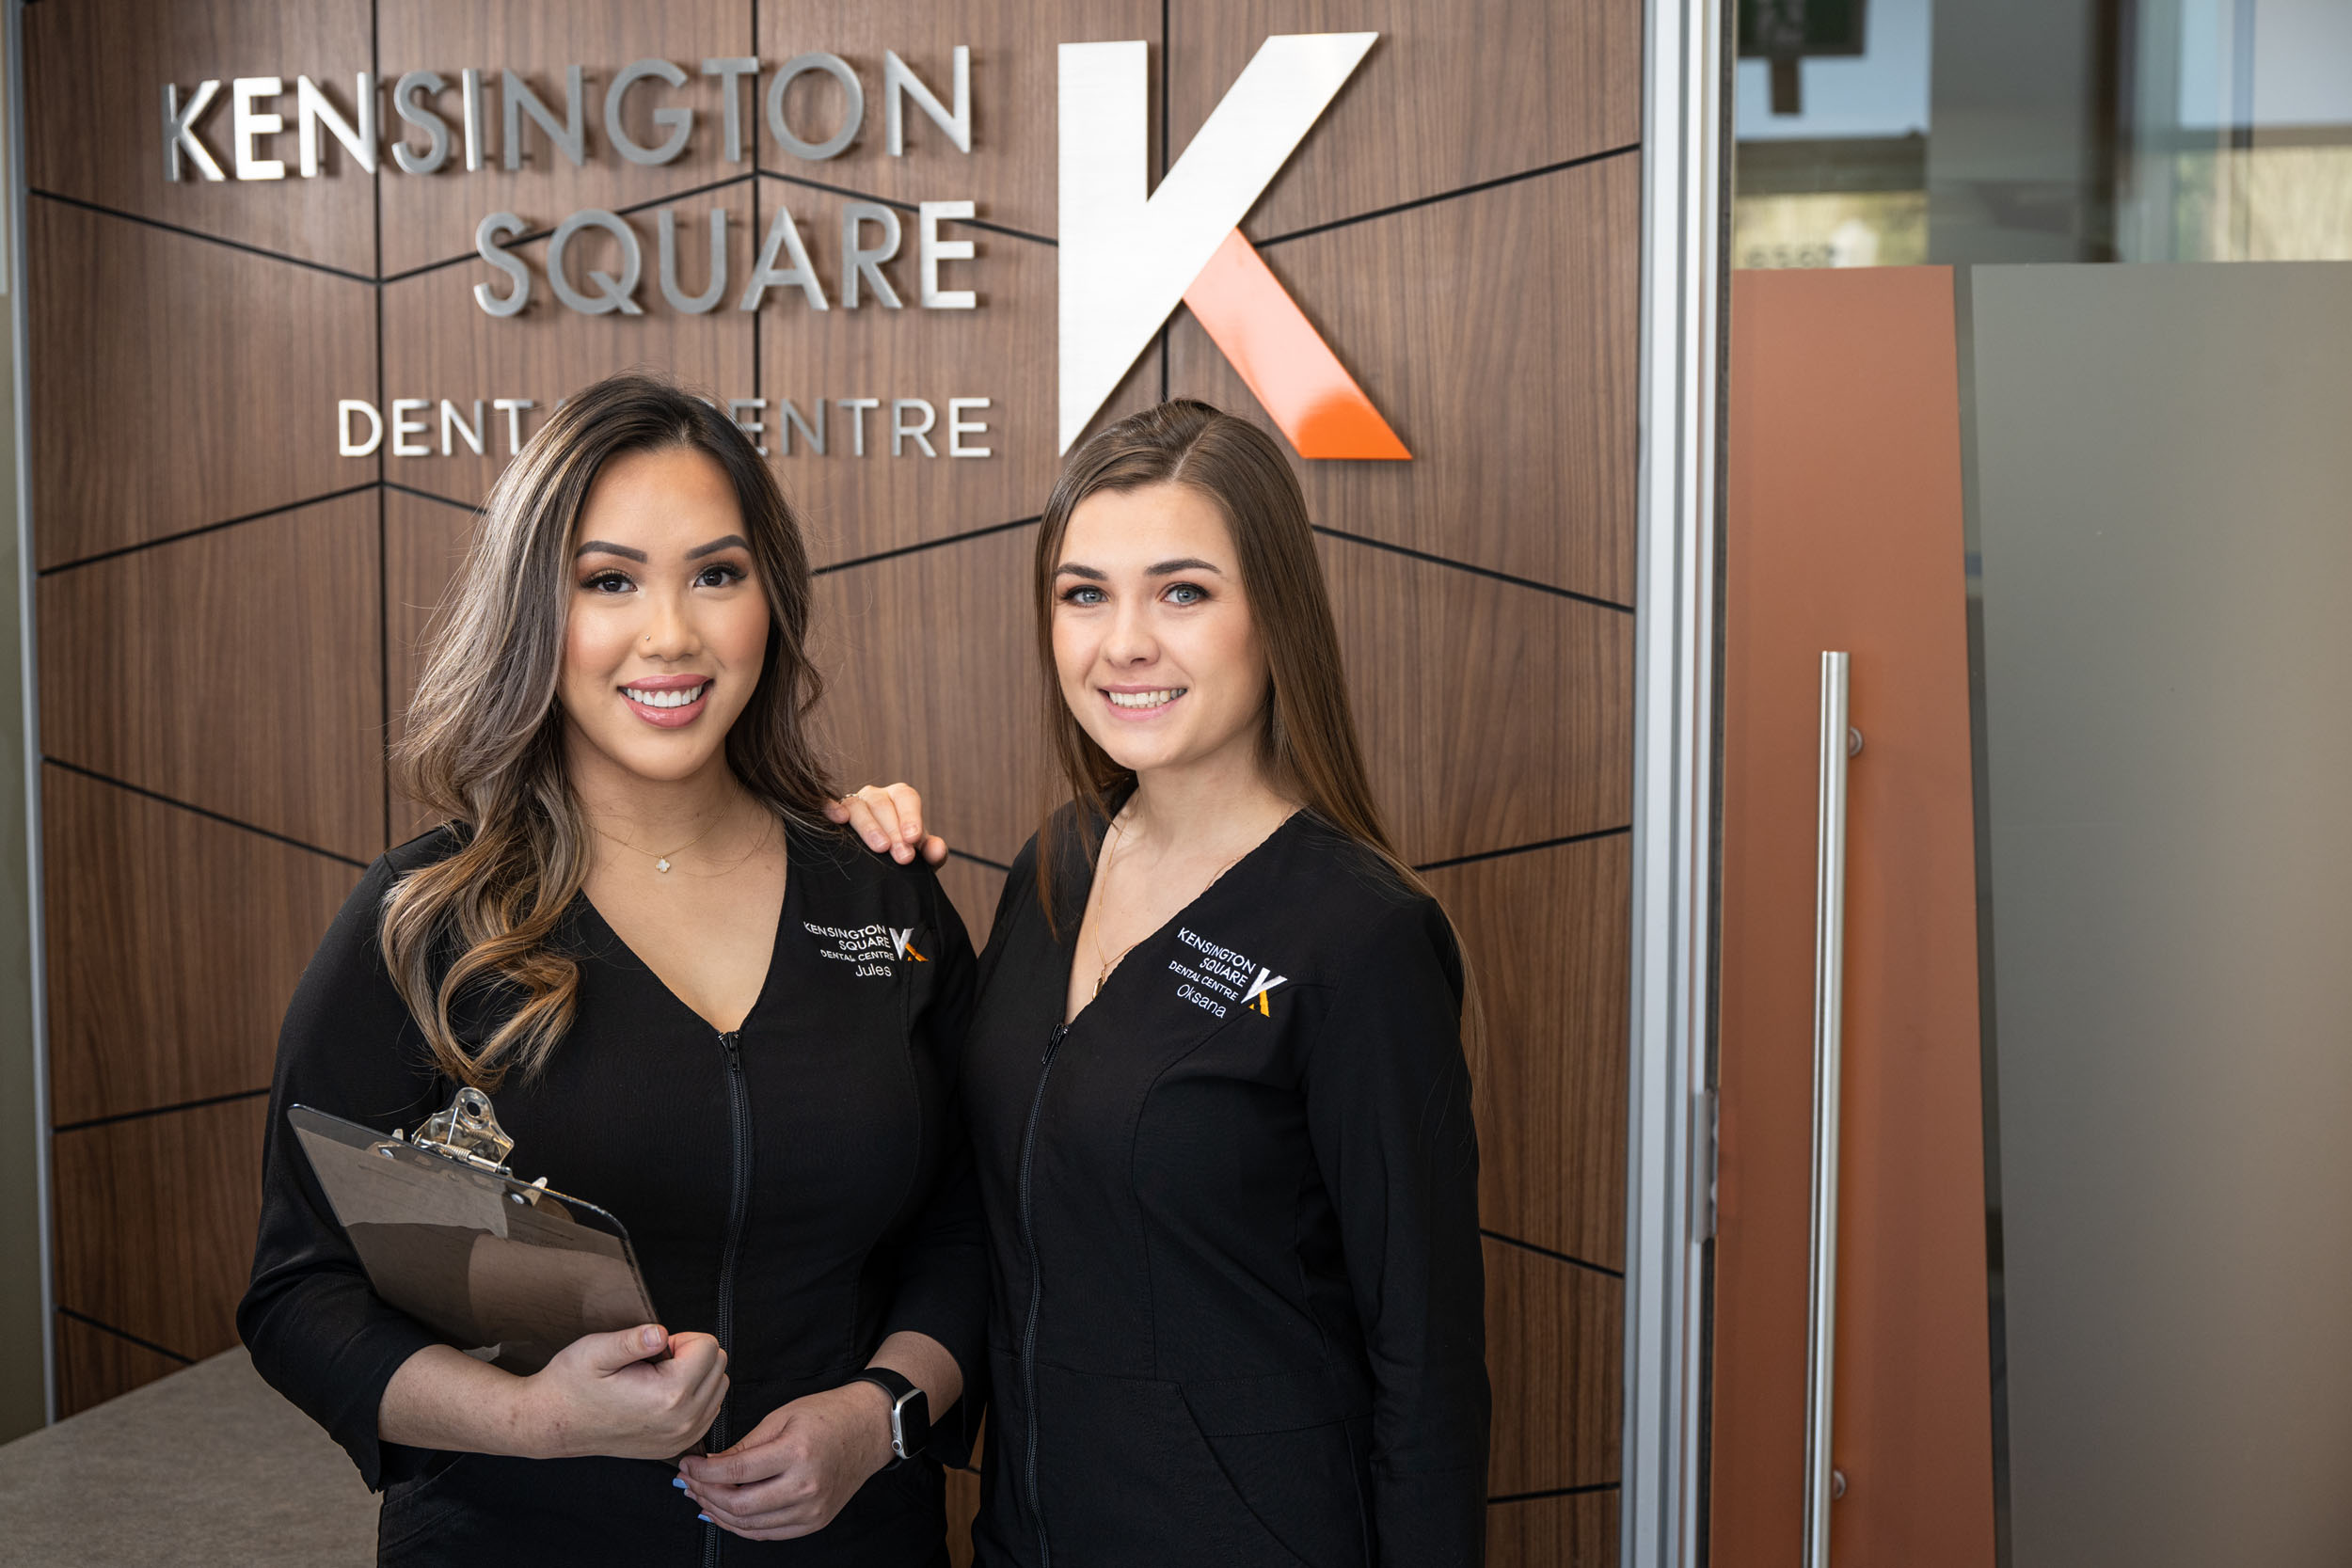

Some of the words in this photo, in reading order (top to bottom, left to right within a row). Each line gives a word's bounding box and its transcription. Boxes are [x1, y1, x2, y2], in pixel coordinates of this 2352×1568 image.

[163, 45, 971, 182] KENSINGTON
[472, 200, 977, 318] SQUARE
[1058, 32, 1412, 459] K
[338, 399, 566, 457] DENT
[707, 398, 992, 457] ENTRE
[803, 921, 887, 940] KENSINGTON
[839, 936, 892, 951] SQUARE
[820, 949, 856, 962] DENTAL
[858, 951, 896, 961] CENTRE
[1177, 927, 1257, 974] KENSINGTON
[855, 963, 892, 977] Jules
[1168, 960, 1201, 983] DENTAL
[1200, 975, 1240, 1002] CENTRE
[1199, 957, 1248, 988] SQUARE
[1176, 984, 1227, 1019] Oksana
